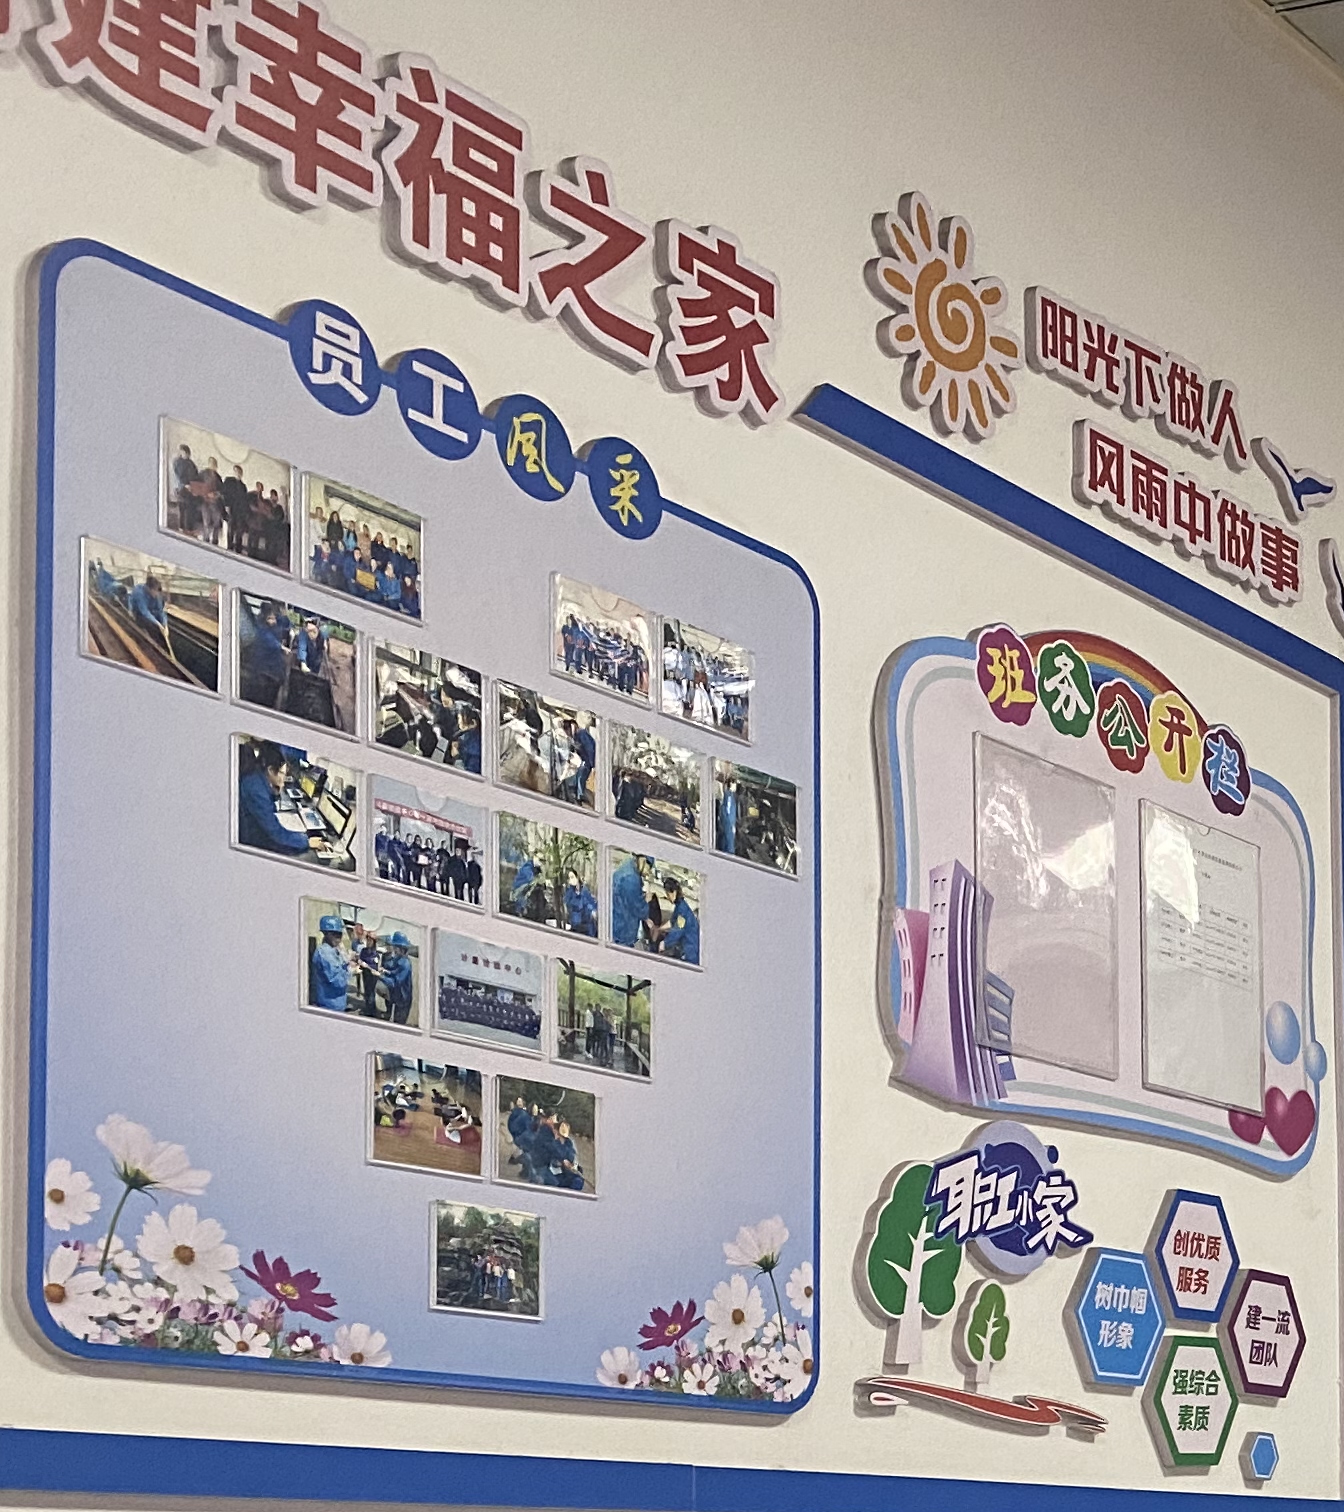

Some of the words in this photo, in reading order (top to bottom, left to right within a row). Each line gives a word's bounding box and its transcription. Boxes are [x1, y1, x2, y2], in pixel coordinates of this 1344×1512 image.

[0, 0, 779, 411] 建幸福之家
[1040, 296, 1248, 461] 阳光下做人
[309, 312, 644, 525] 员工风采
[1087, 429, 1300, 592] 风雨中做事
[986, 645, 1245, 804] 班务公开栏
[935, 1154, 1091, 1251] 职工小家
[1173, 1230, 1222, 1263] 创优质
[1176, 1267, 1209, 1295] 服务
[1094, 1281, 1147, 1317] 树巾帼
[1098, 1320, 1133, 1350] 形象
[1245, 1305, 1292, 1337] 建一流
[1250, 1339, 1279, 1368] 团队
[1172, 1369, 1222, 1397] 强综合
[1177, 1405, 1210, 1432] 素质
